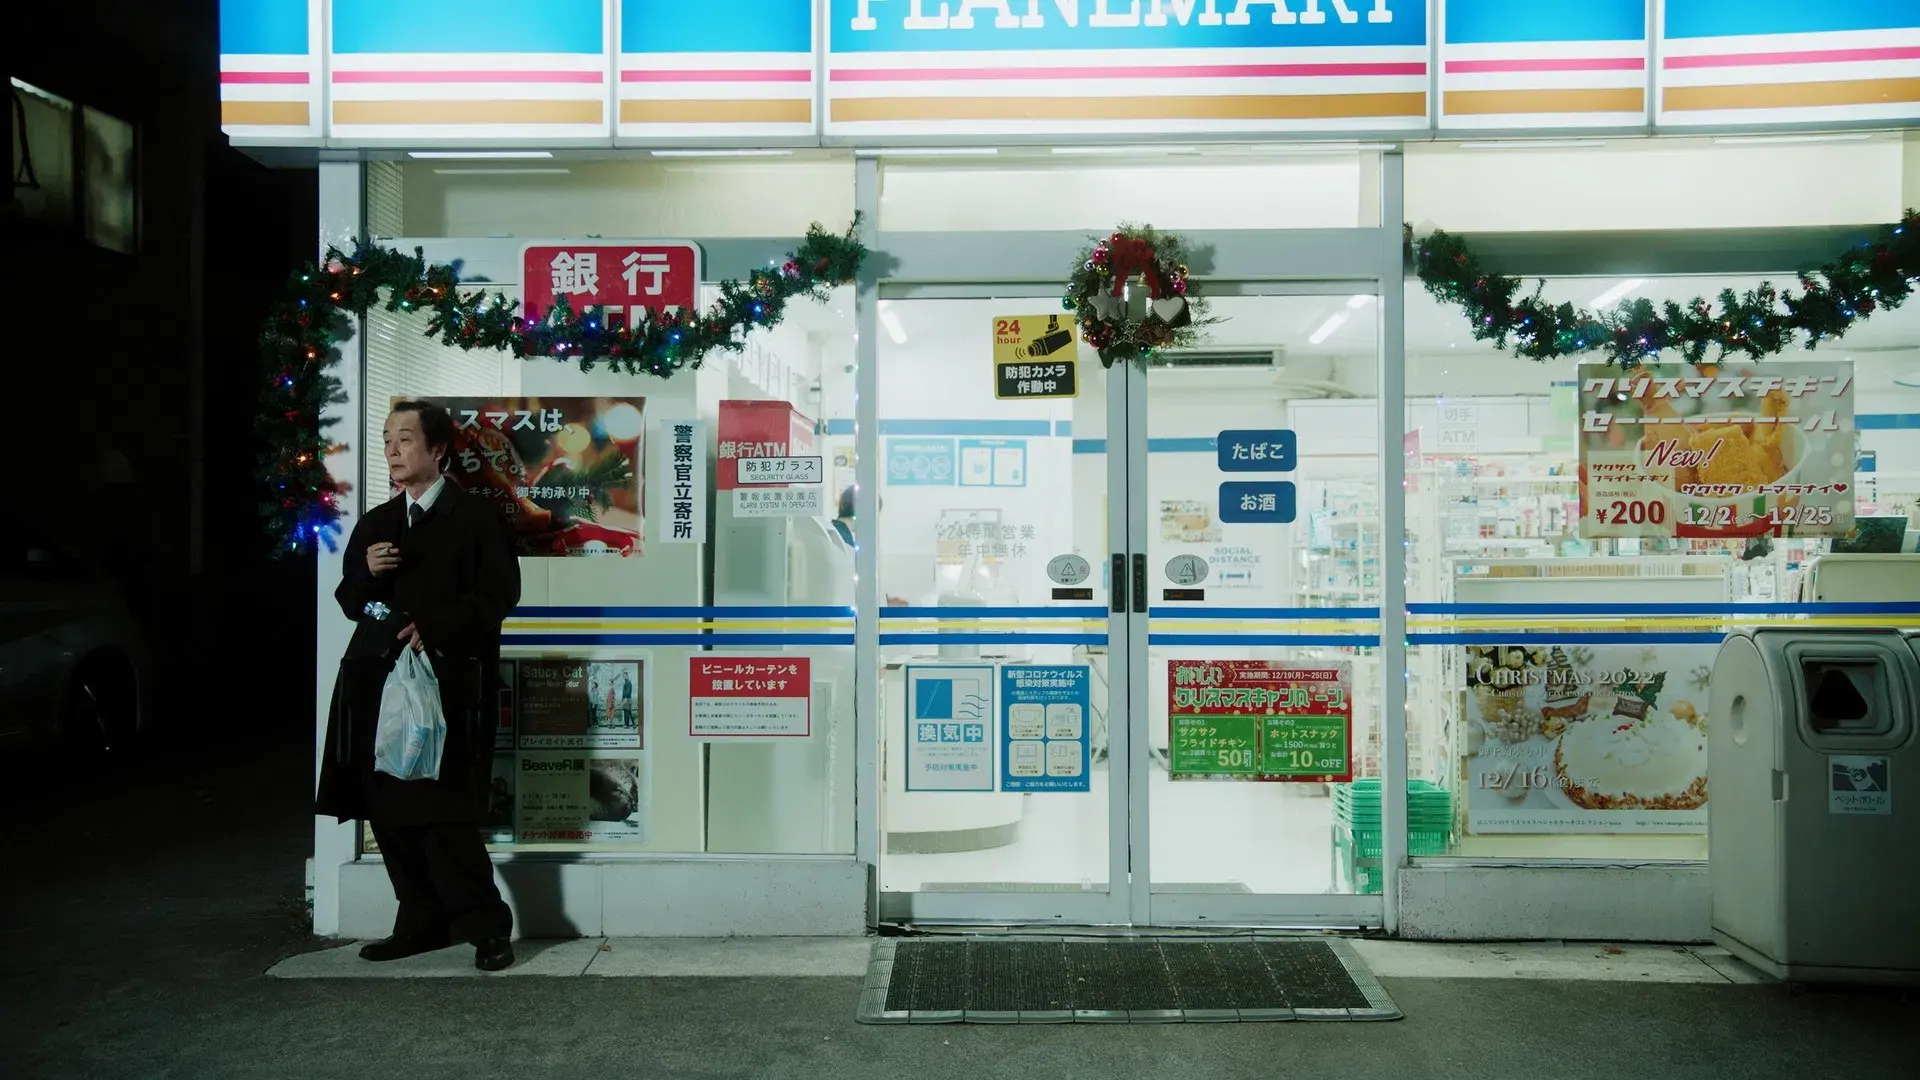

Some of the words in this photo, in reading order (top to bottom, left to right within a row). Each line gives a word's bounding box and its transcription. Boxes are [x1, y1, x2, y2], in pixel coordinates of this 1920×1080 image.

[550, 251, 671, 296] 銀行
[996, 319, 1021, 335] 24
[997, 336, 1021, 344] hour
[1005, 364, 1067, 379] 防犯カメラ
[1017, 379, 1057, 394] 作動中
[1582, 375, 1853, 399] クリスマスチキン
[444, 407, 575, 434] スマスは、
[1444, 407, 1473, 422] 切手
[1442, 430, 1475, 443] ATM
[719, 440, 787, 459] 銀行ATM
[1232, 442, 1284, 460] たばこ
[442, 447, 519, 475] ちで。
[745, 460, 815, 472] 防犯ガラス
[673, 424, 693, 539] 警察官立寄所
[1240, 493, 1277, 511] お酒
[957, 542, 1027, 559] 年中無休
[1214, 546, 1252, 555] SOCIAL
[1209, 555, 1261, 564] DISTANCE
[523, 665, 558, 679] Saucy
[562, 665, 583, 678] Cat
[702, 664, 798, 675] ビニールカーテンを
[1007, 670, 1083, 679] 新型コロナウイルス
[1597, 669, 1656, 685] 2022
[711, 679, 788, 691] 設置しています
[1015, 679, 1075, 688] 感染対策実施中
[1175, 685, 1346, 708] クリスマスキャンペーン
[919, 724, 982, 742] 換気中
[1178, 727, 1217, 737] サクサク
[1270, 729, 1338, 739] ホットスナック
[1179, 738, 1247, 748] フライドチキン
[1834, 794, 1886, 805] ペットボトル
